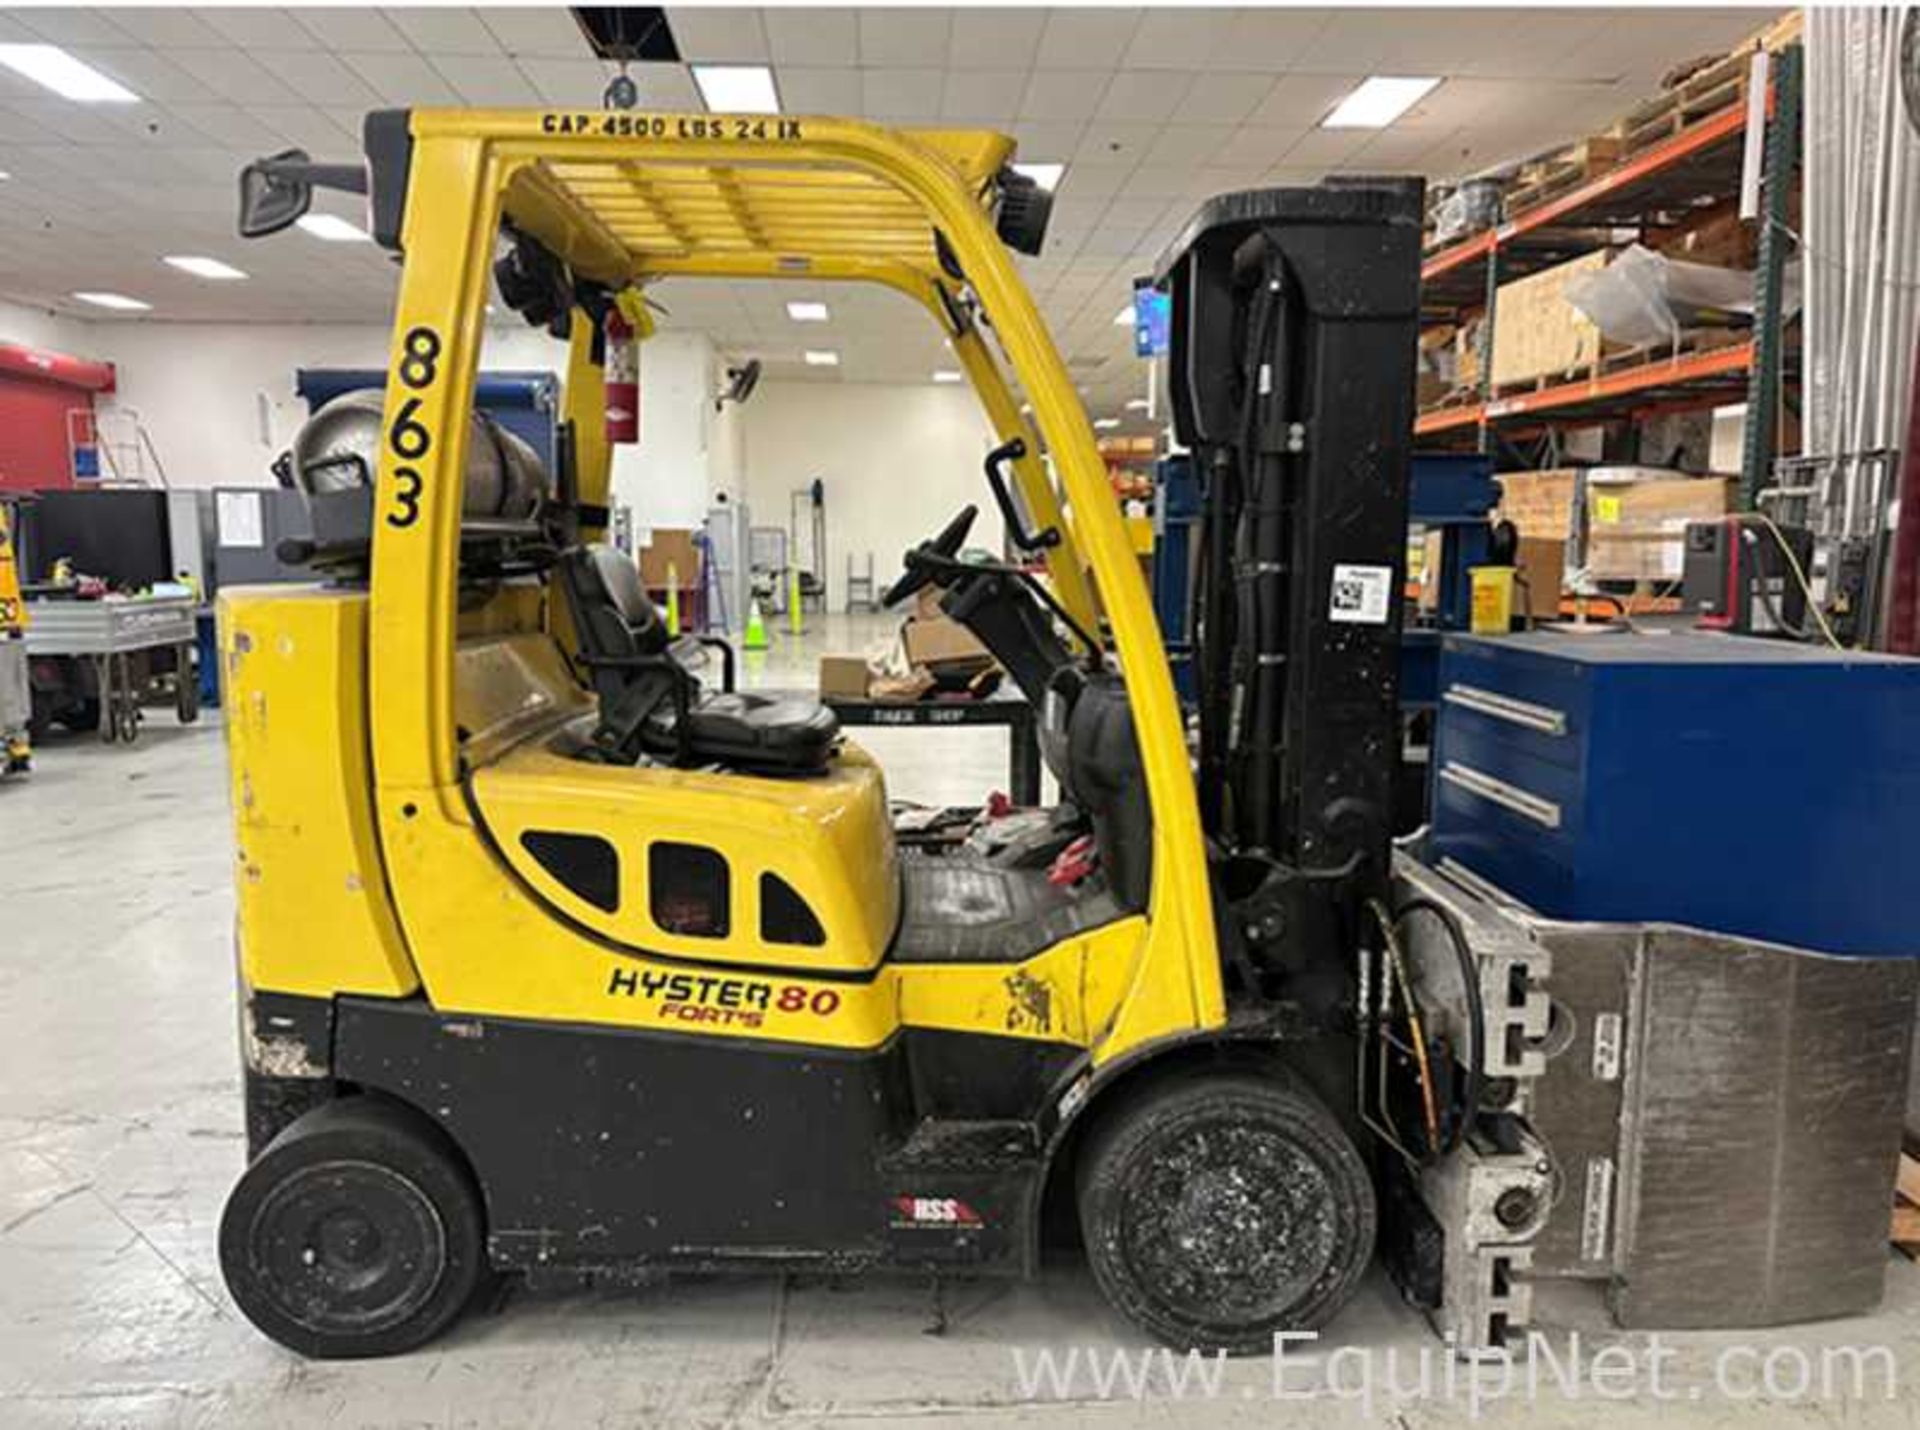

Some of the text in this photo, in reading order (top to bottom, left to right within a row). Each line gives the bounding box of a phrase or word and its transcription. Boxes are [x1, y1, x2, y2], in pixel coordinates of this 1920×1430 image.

[677, 118, 725, 139] LBS
[736, 119, 767, 139] 24
[386, 326, 442, 529] 863
[606, 968, 841, 1017] HYSTER 80
